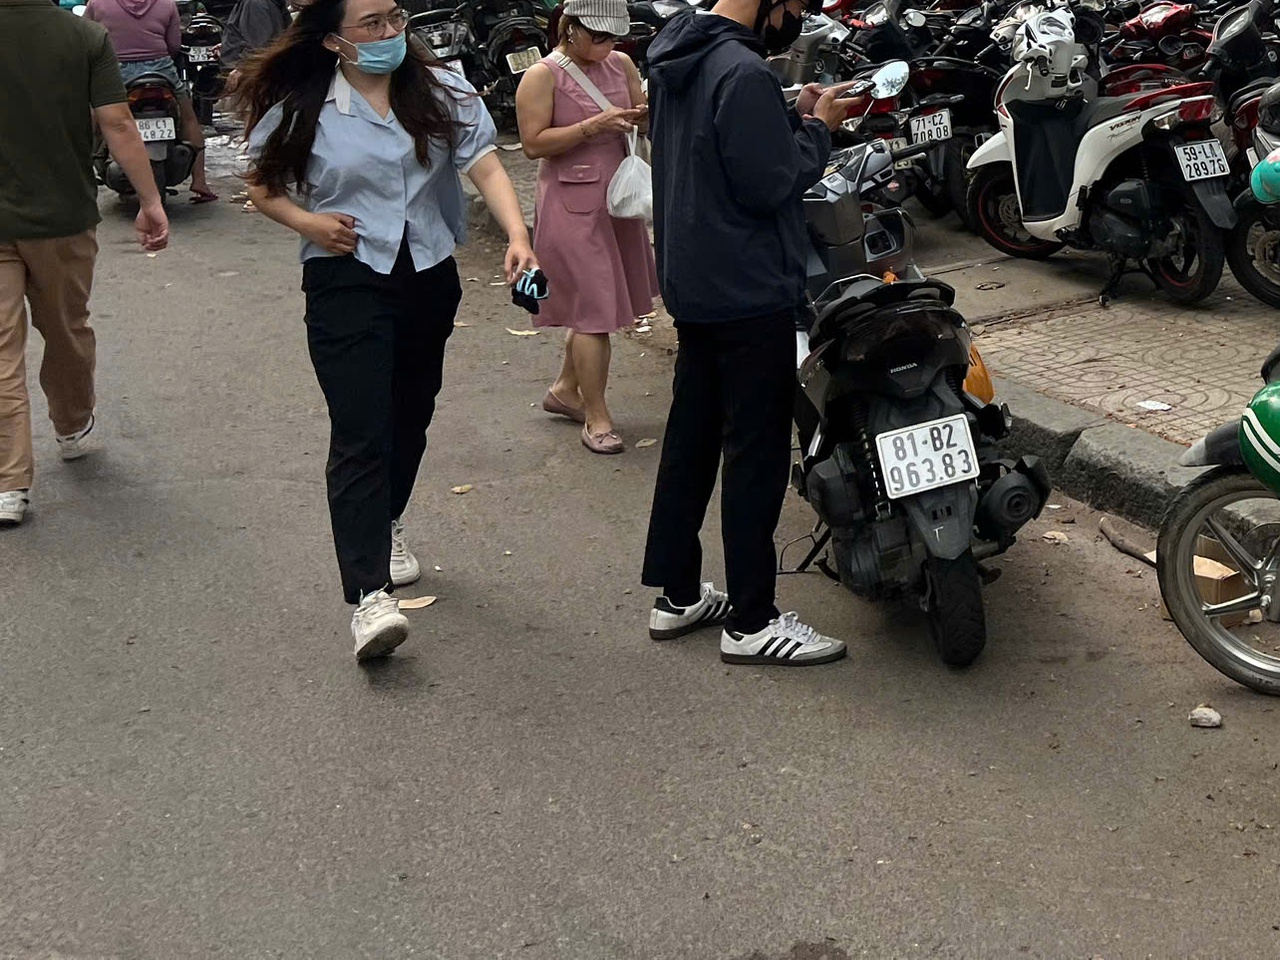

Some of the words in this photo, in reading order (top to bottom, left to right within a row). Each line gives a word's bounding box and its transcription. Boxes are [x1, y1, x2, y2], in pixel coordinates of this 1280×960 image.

[1182, 143, 1218, 162] 59-LA
[1185, 158, 1226, 179] 289.76
[890, 362, 918, 374] HONDA
[892, 423, 958, 461] 81-B2
[889, 448, 973, 492] 963.83
